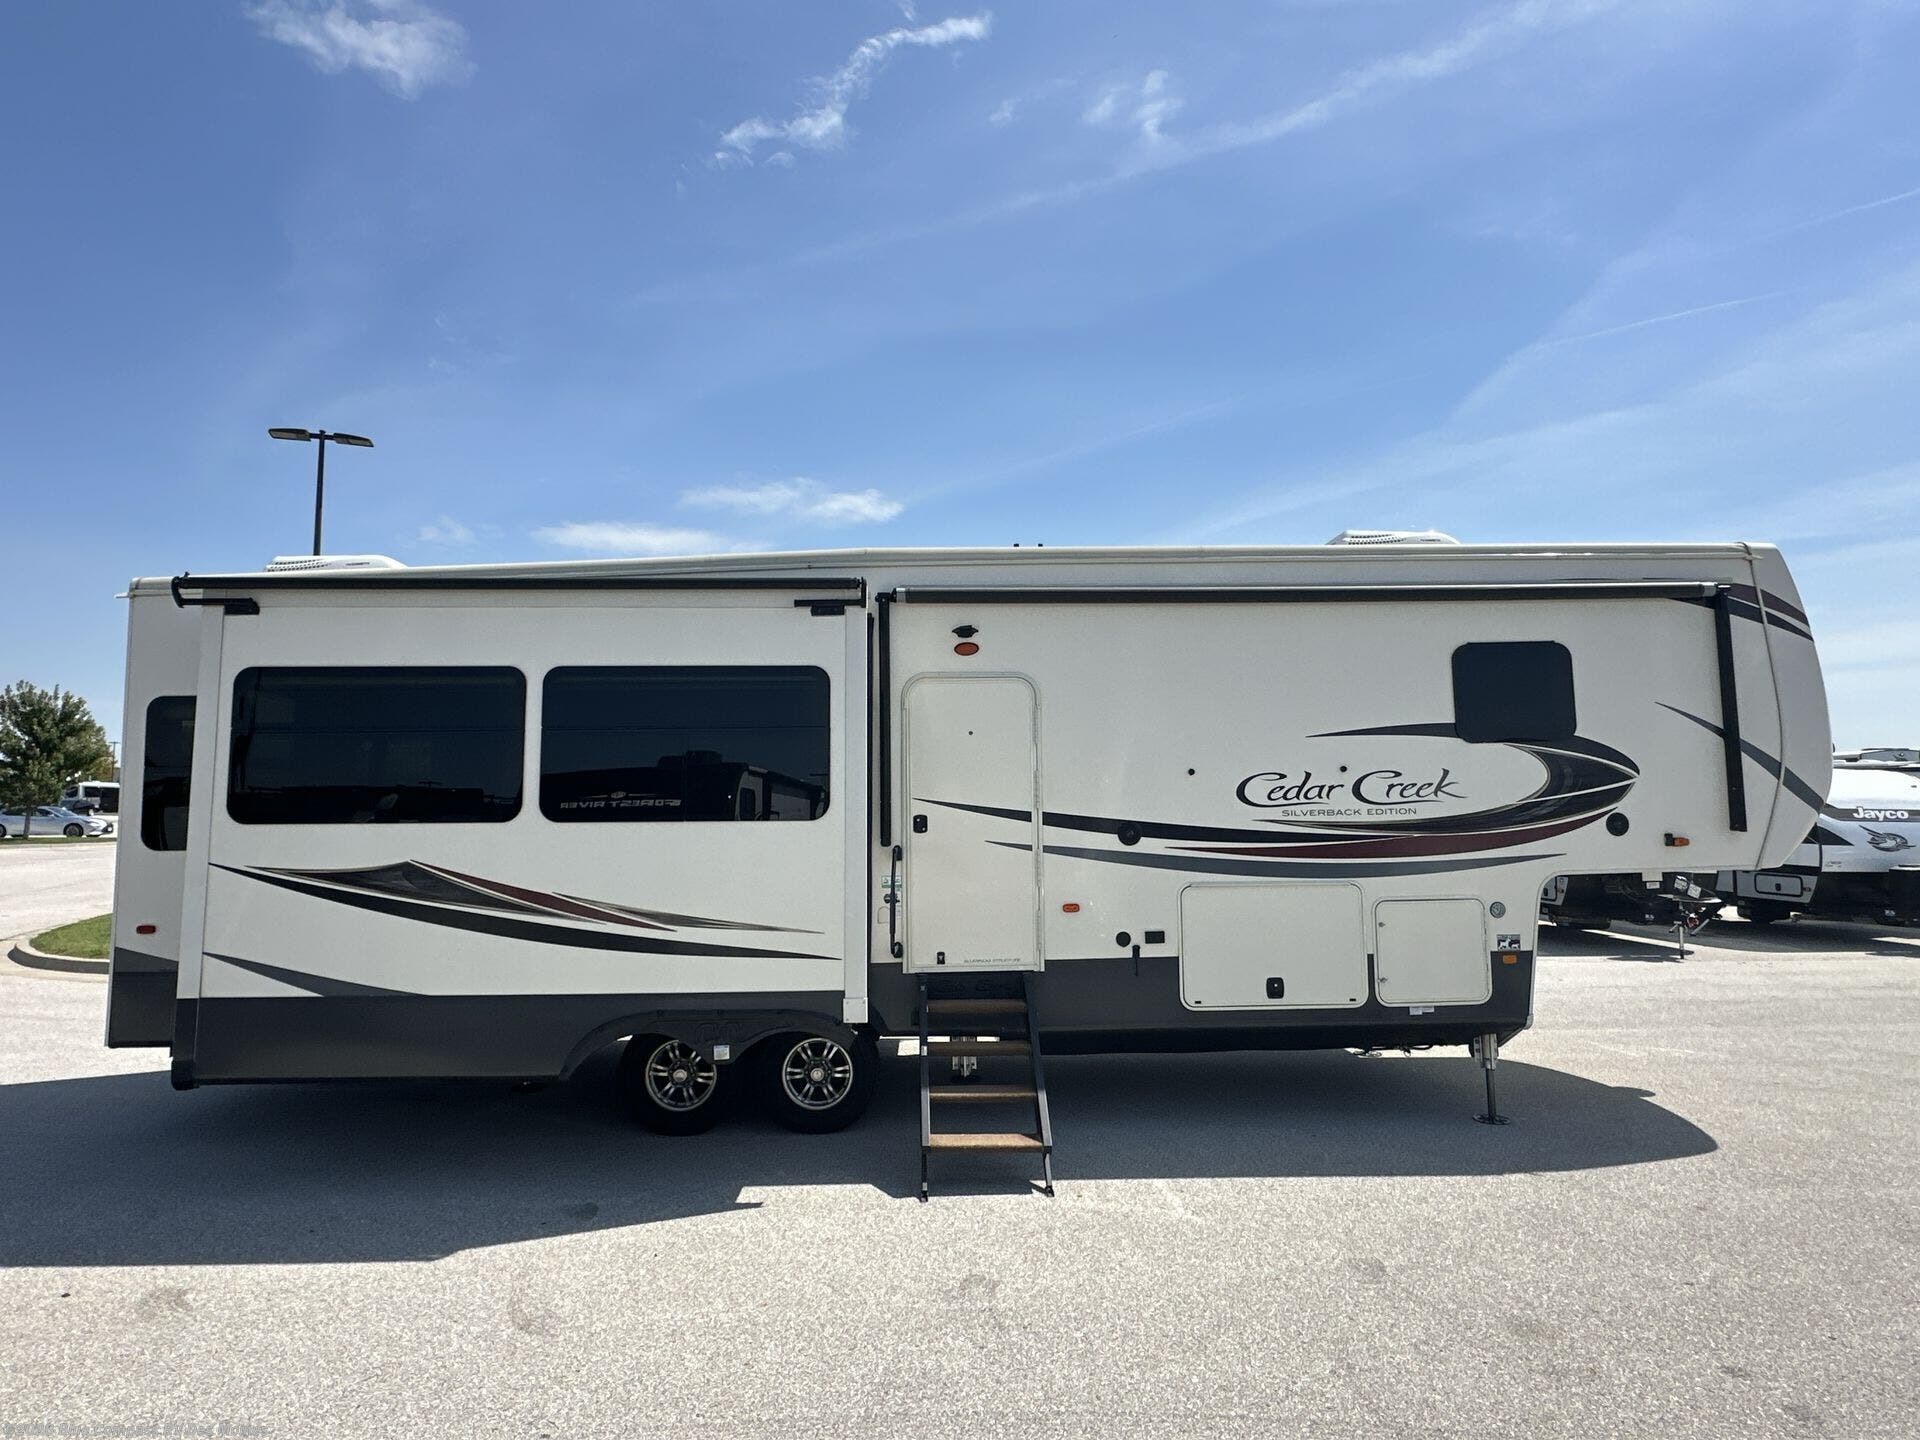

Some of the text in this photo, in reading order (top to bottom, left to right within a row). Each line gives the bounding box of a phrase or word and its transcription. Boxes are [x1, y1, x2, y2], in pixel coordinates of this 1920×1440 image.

[1235, 768, 1468, 808] Cedar Creek
[1281, 807, 1418, 817] SILVERBACK EDITION
[1852, 806, 1909, 821] Jayco
